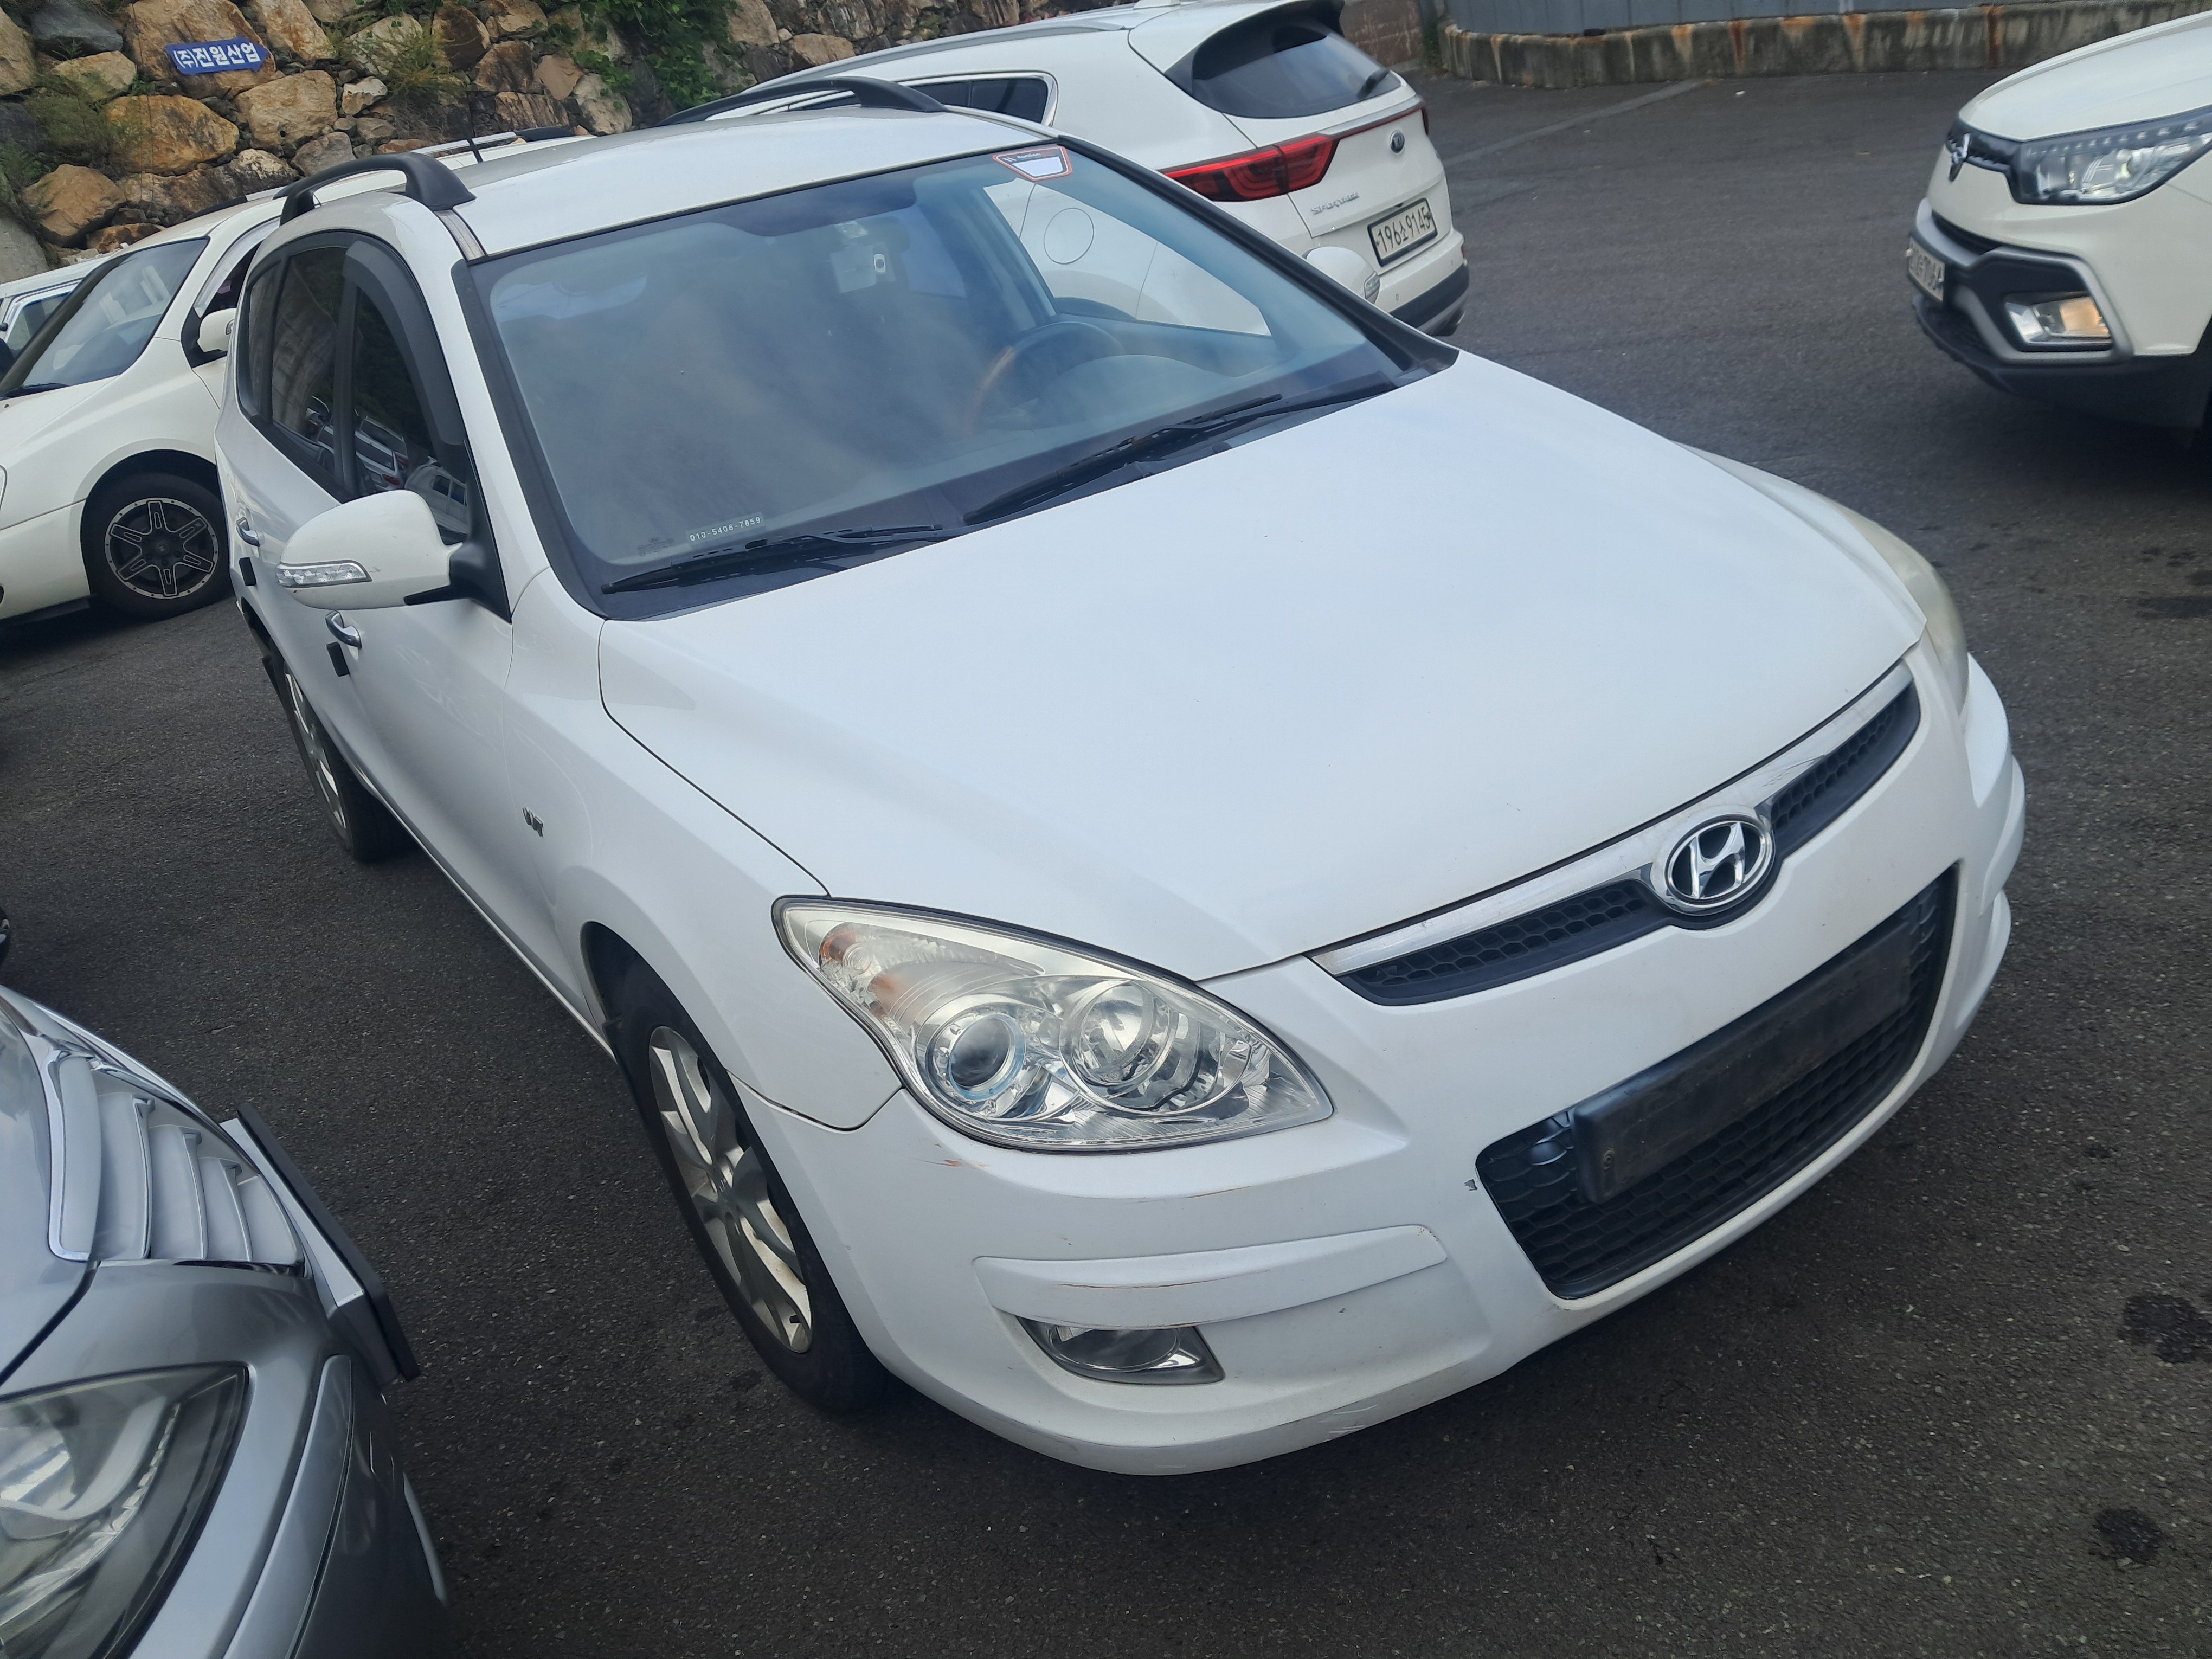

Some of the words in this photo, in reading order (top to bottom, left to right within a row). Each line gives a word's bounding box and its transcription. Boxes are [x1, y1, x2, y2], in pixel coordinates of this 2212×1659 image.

[173, 42, 261, 69] (주)진원산업
[1378, 206, 1431, 252] 196소9145
[689, 516, 761, 542] 010-5406-7859
